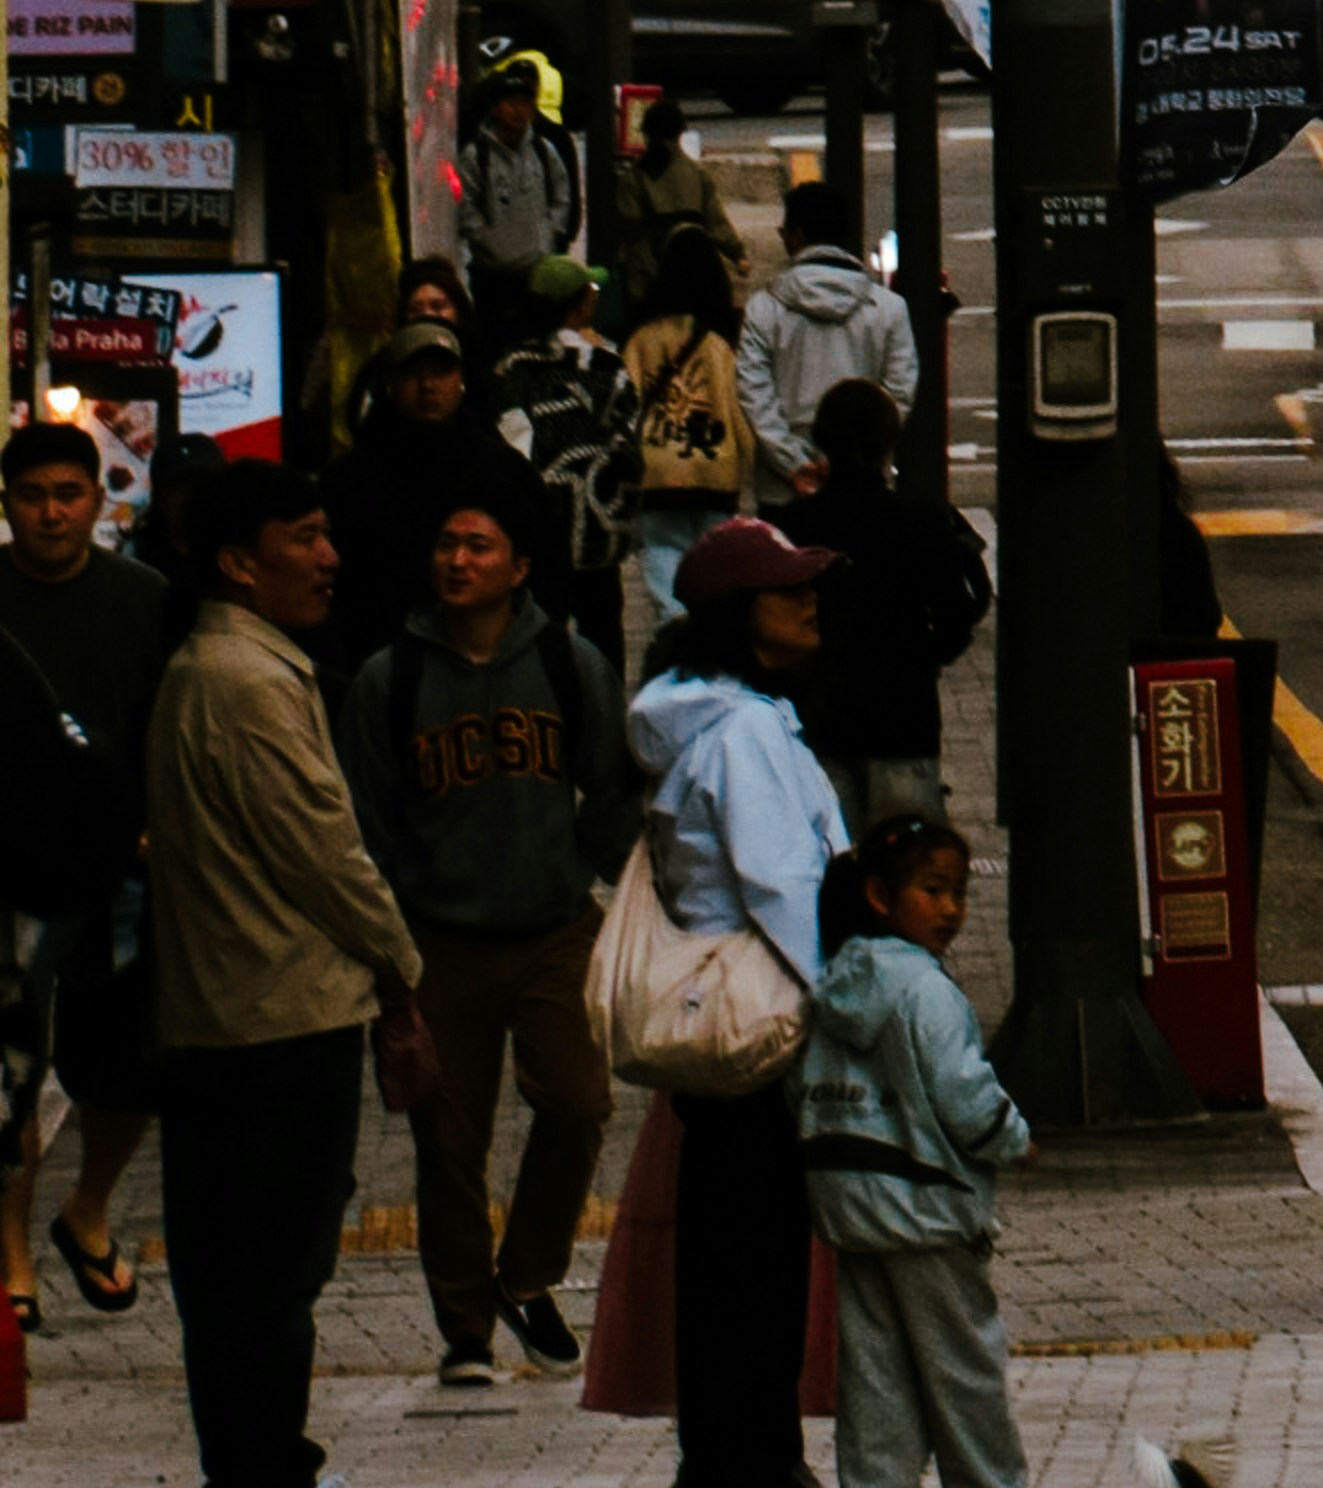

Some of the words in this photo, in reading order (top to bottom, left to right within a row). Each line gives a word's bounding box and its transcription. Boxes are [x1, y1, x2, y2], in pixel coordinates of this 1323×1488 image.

[81, 139, 154, 173] 30%
[77, 188, 232, 228] 스터디카페
[74, 327, 144, 353] Praha
[1157, 683, 1194, 793] 소화기
